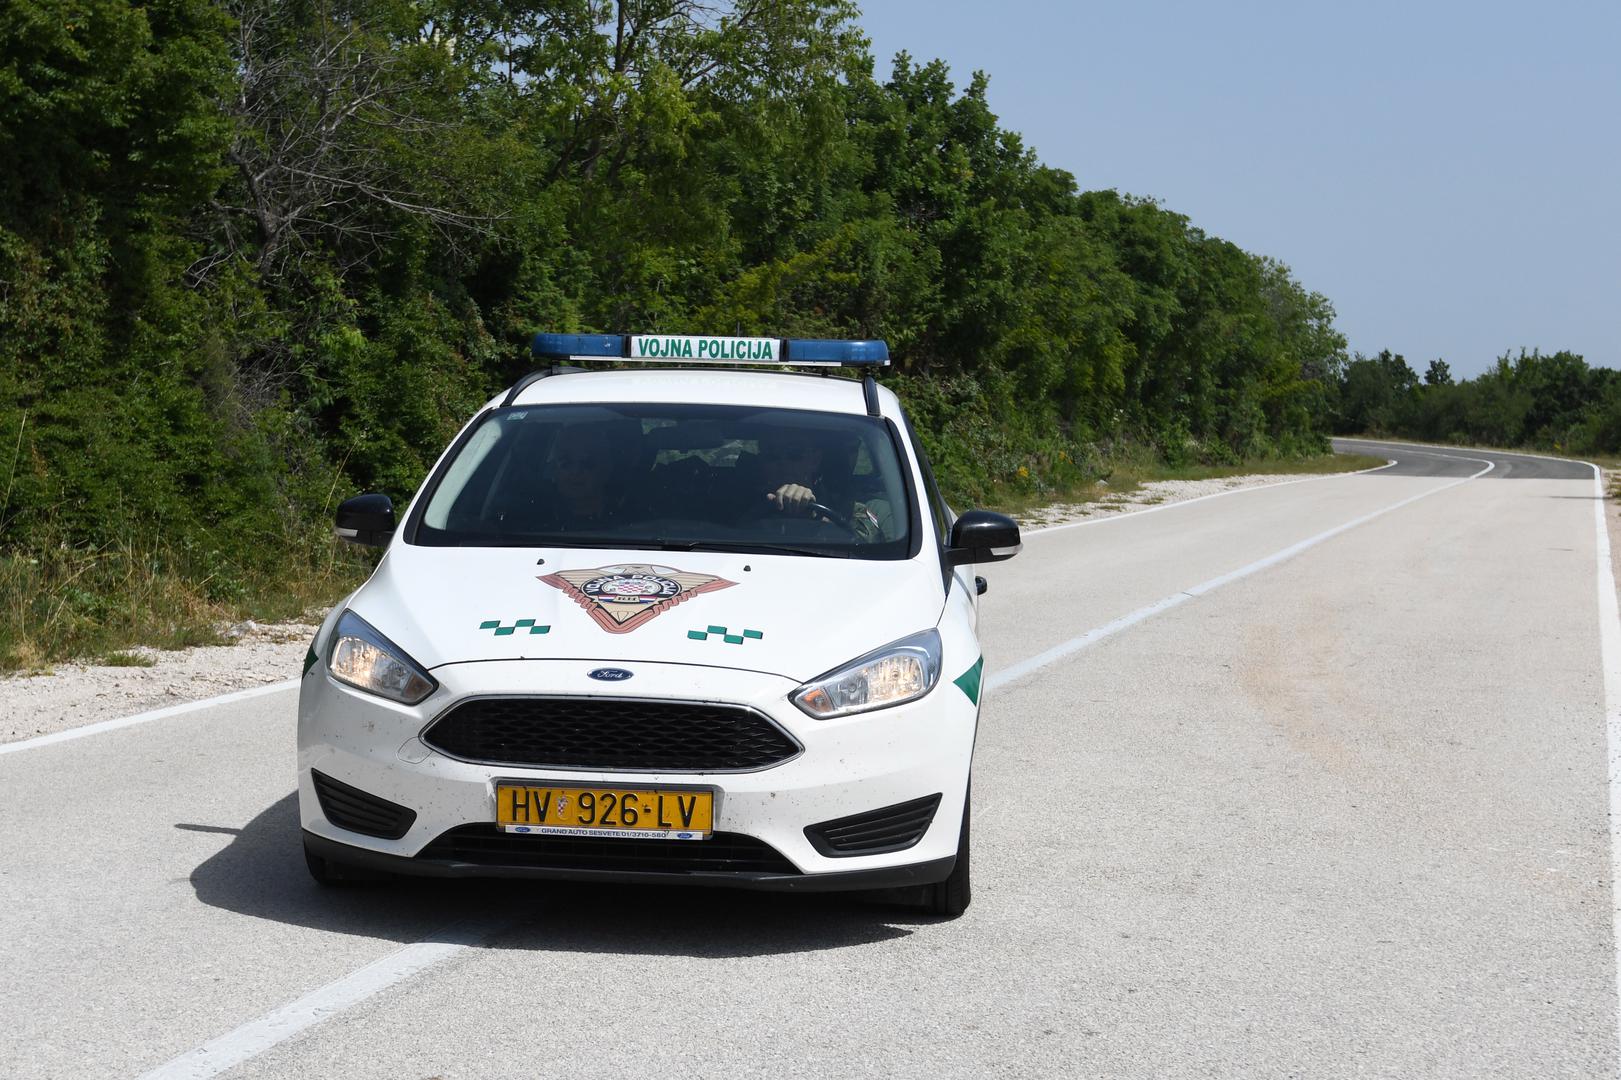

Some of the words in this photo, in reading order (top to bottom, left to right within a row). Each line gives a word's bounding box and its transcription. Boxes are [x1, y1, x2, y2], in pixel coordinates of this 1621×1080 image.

[638, 338, 693, 357] VOJNA
[698, 339, 773, 360] POLICIJA
[597, 670, 623, 678] Ford
[512, 790, 551, 822] HV
[568, 828, 588, 836] AUTO
[588, 829, 620, 837] SESVETE
